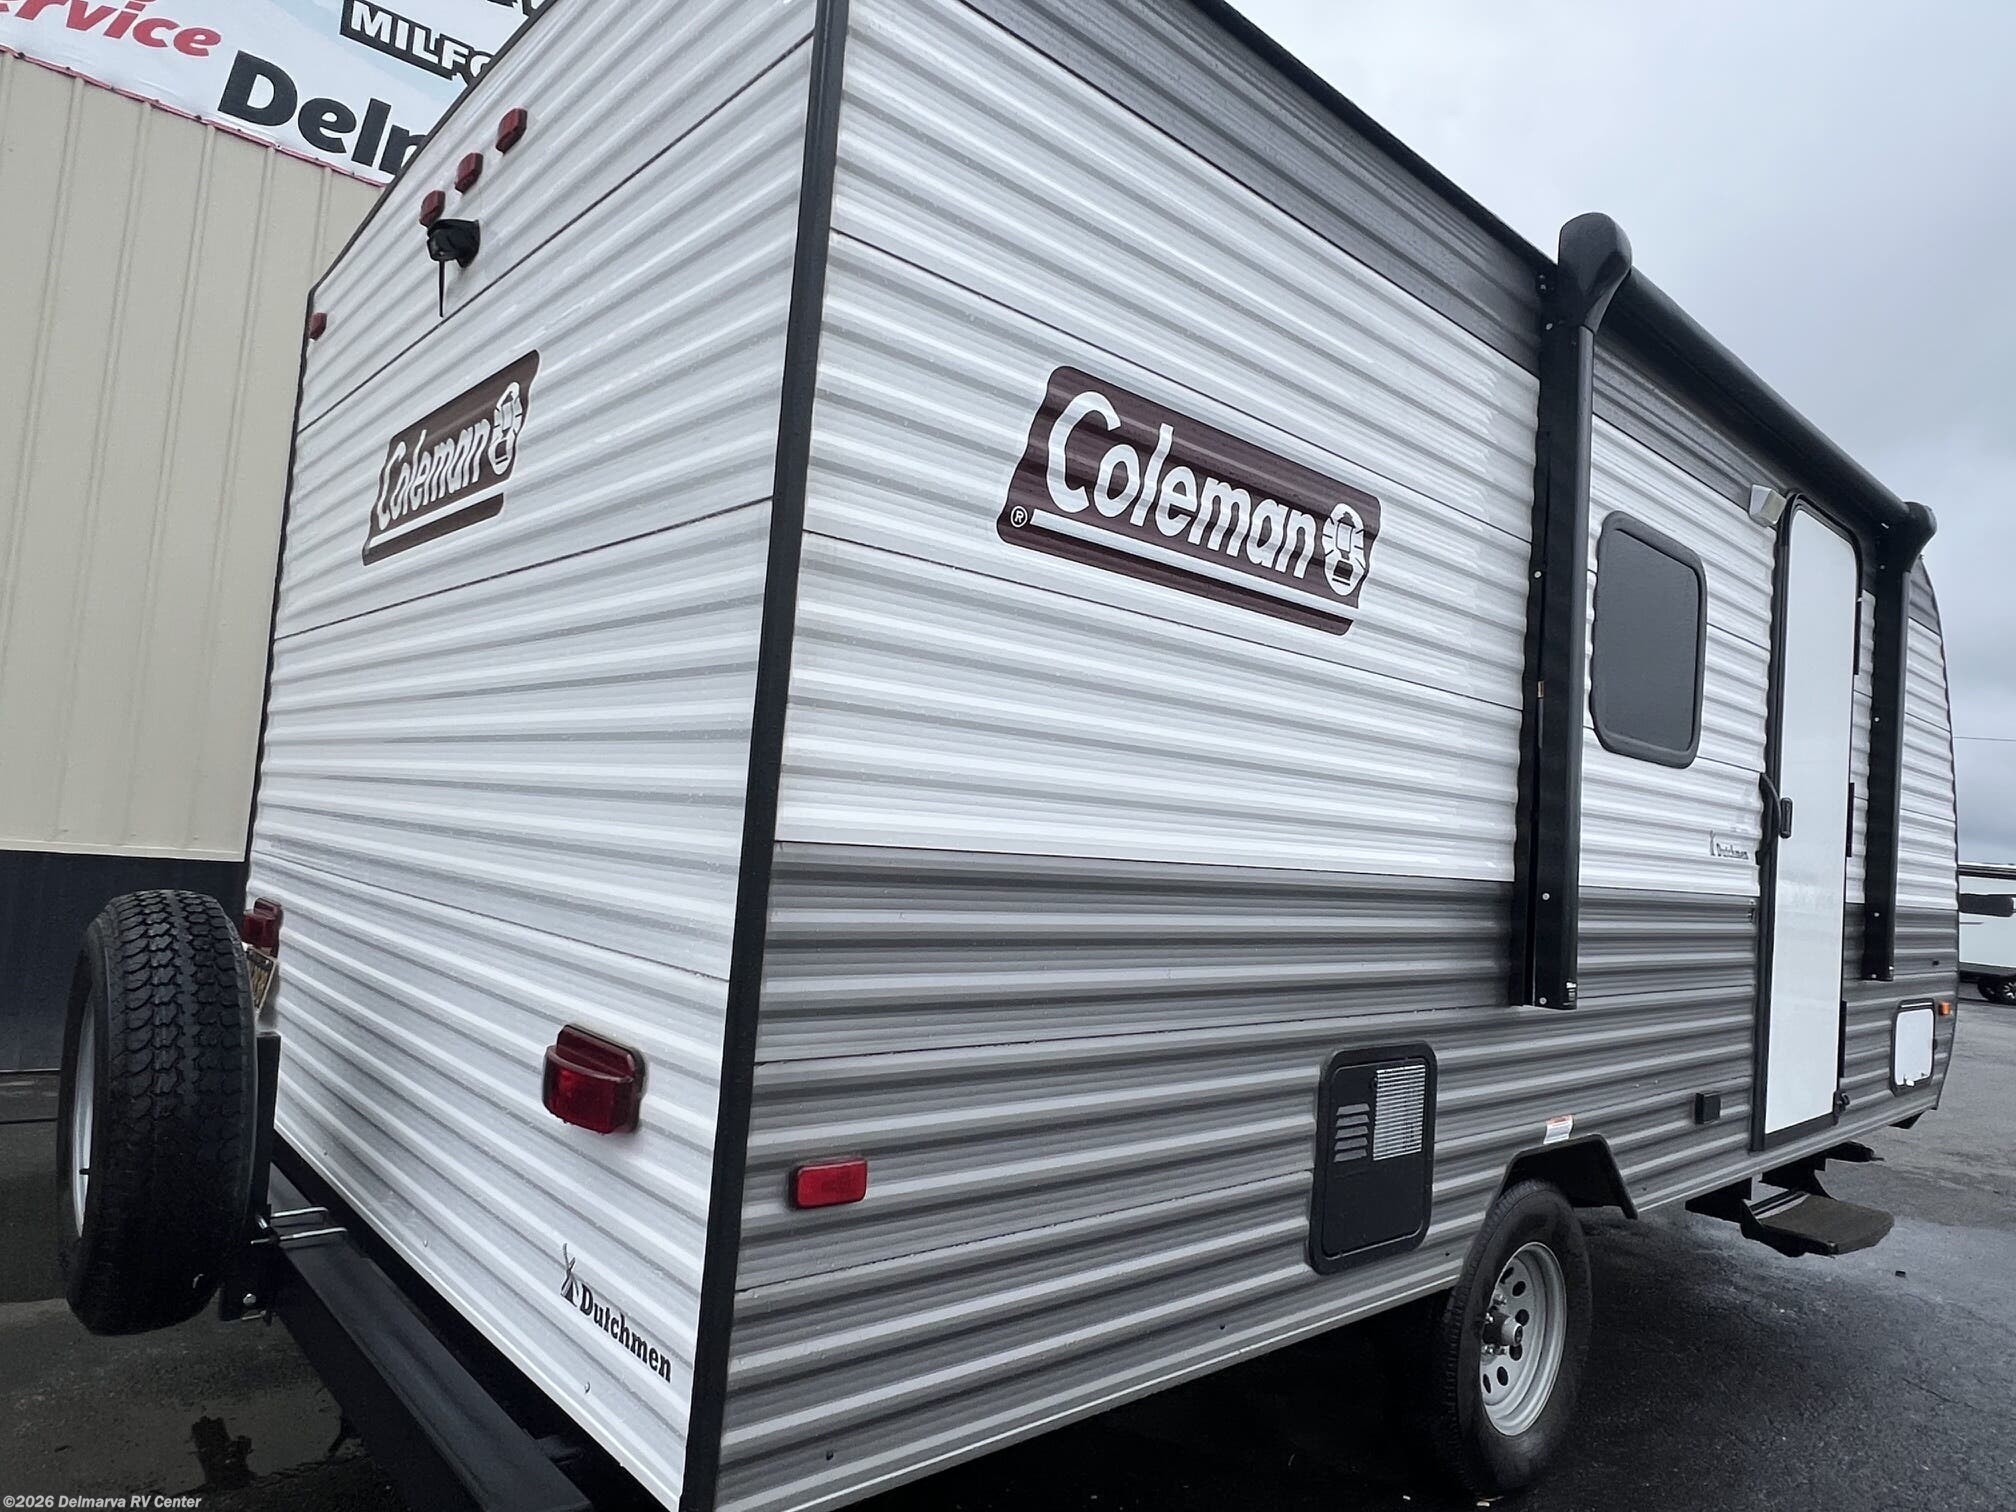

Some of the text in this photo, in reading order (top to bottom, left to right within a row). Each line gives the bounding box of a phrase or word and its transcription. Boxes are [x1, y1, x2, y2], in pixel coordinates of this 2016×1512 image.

[0, 0, 222, 57] rvice
[376, 418, 491, 531] Coleman
[1046, 390, 1317, 580] Coleman
[579, 1282, 672, 1384] Dutchmen
